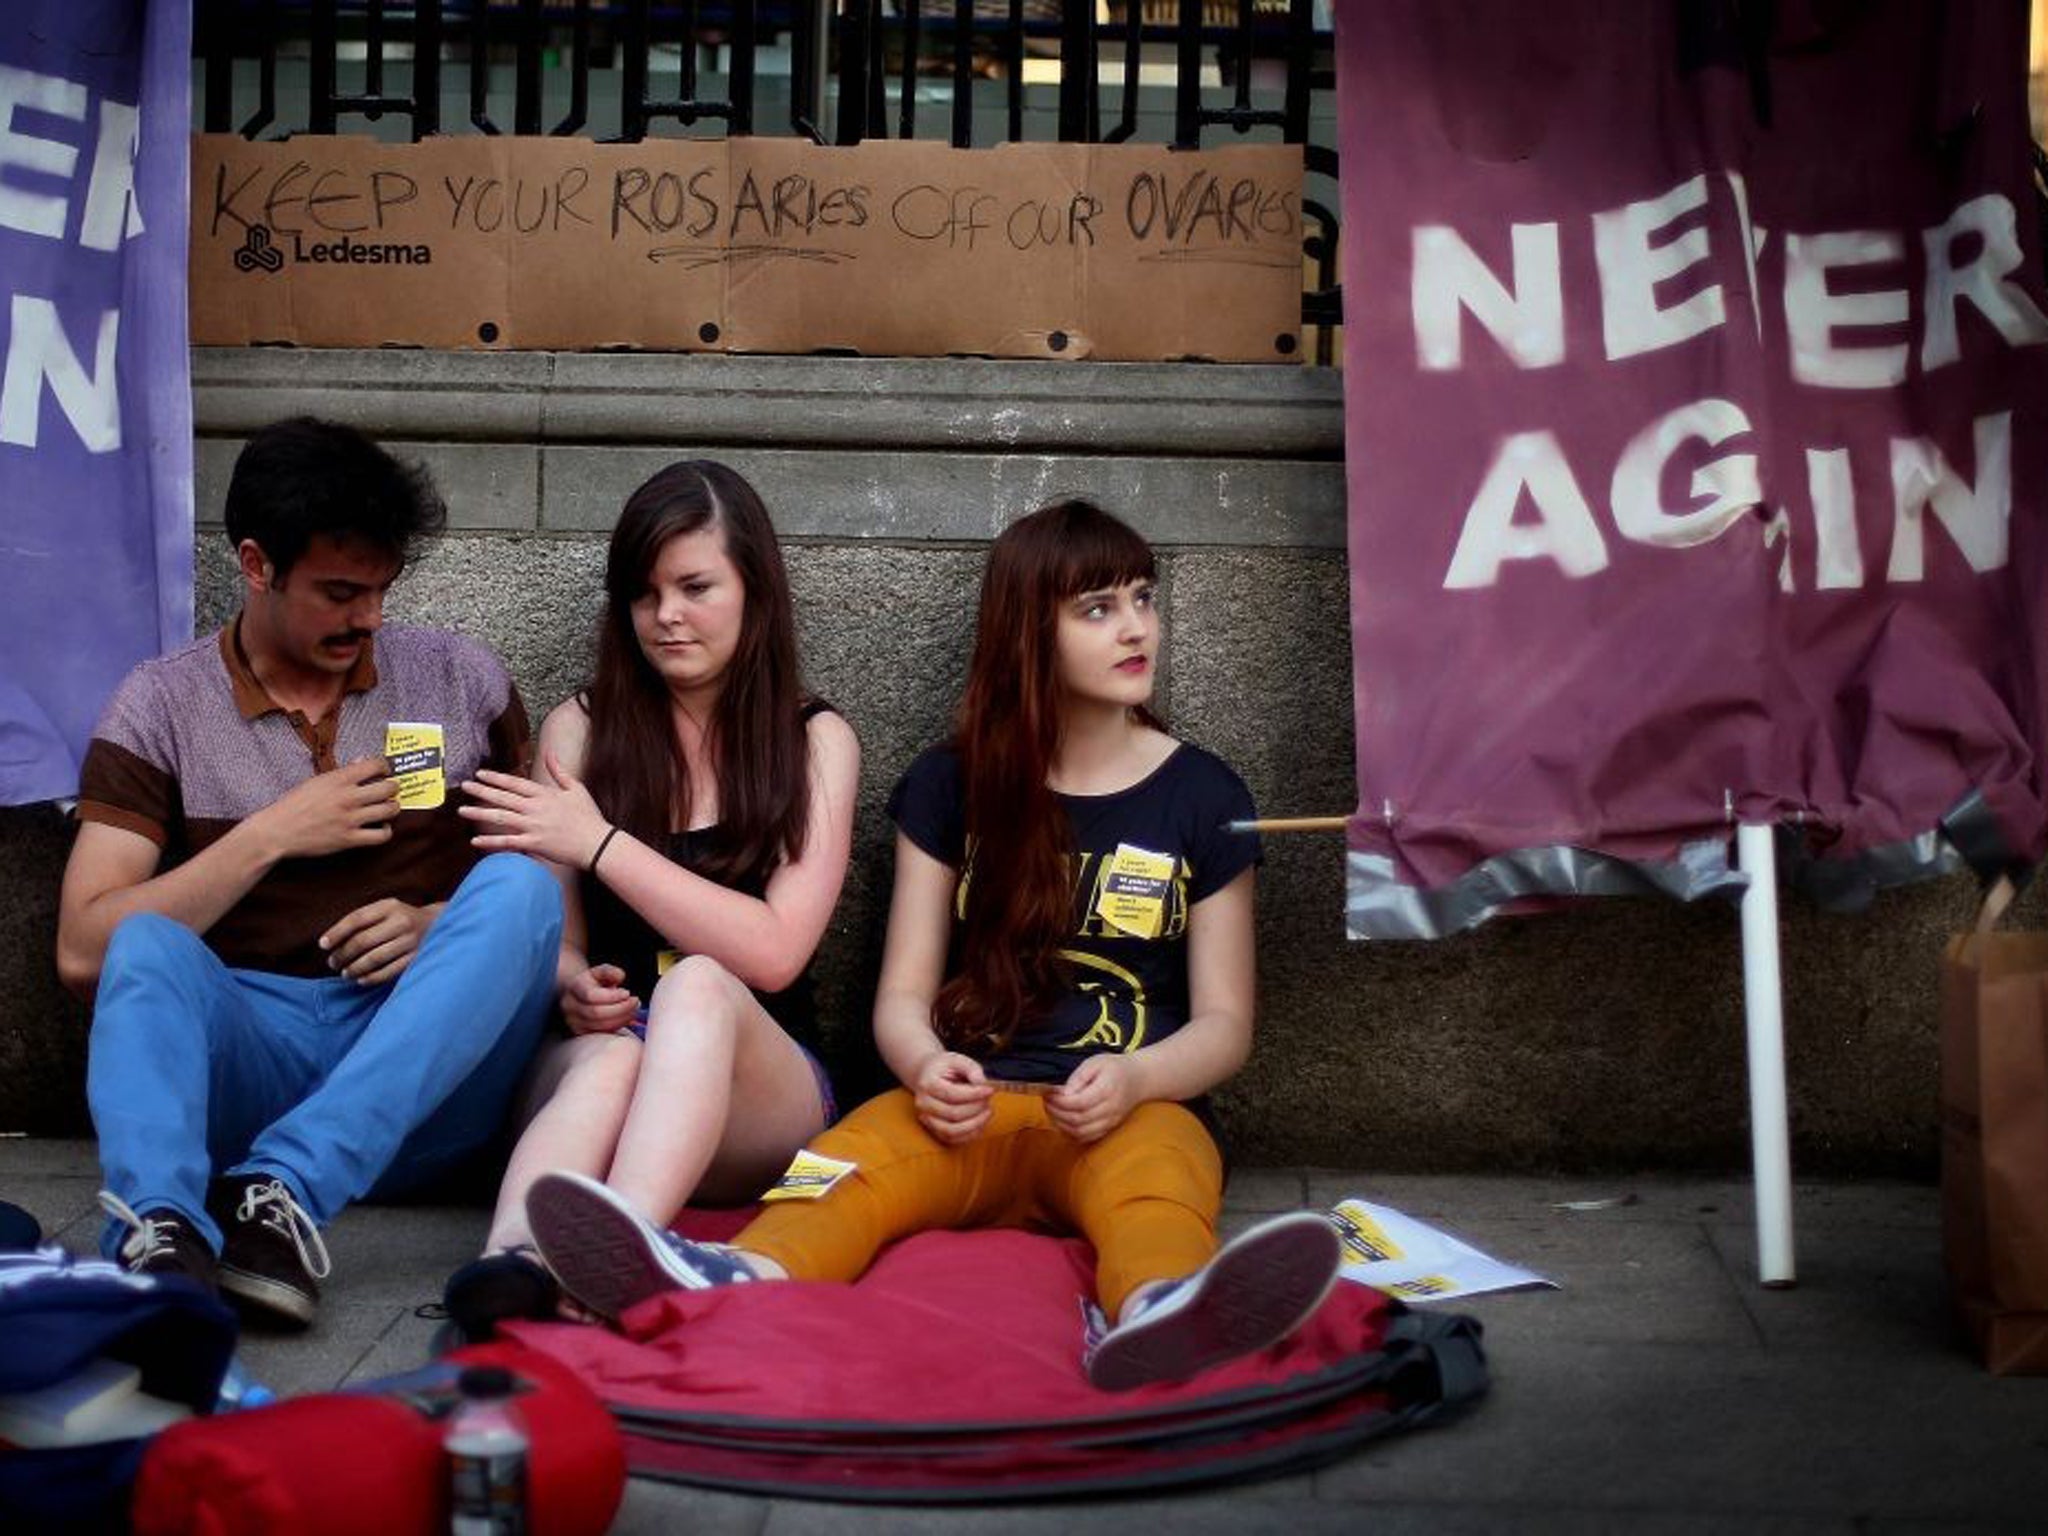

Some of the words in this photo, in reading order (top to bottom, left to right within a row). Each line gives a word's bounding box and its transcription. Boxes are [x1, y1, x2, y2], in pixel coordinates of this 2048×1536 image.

[211, 161, 418, 238] KEEP
[444, 167, 593, 233] YOUR
[1007, 192, 1103, 250] OUR
[294, 236, 431, 265] Ledesma
